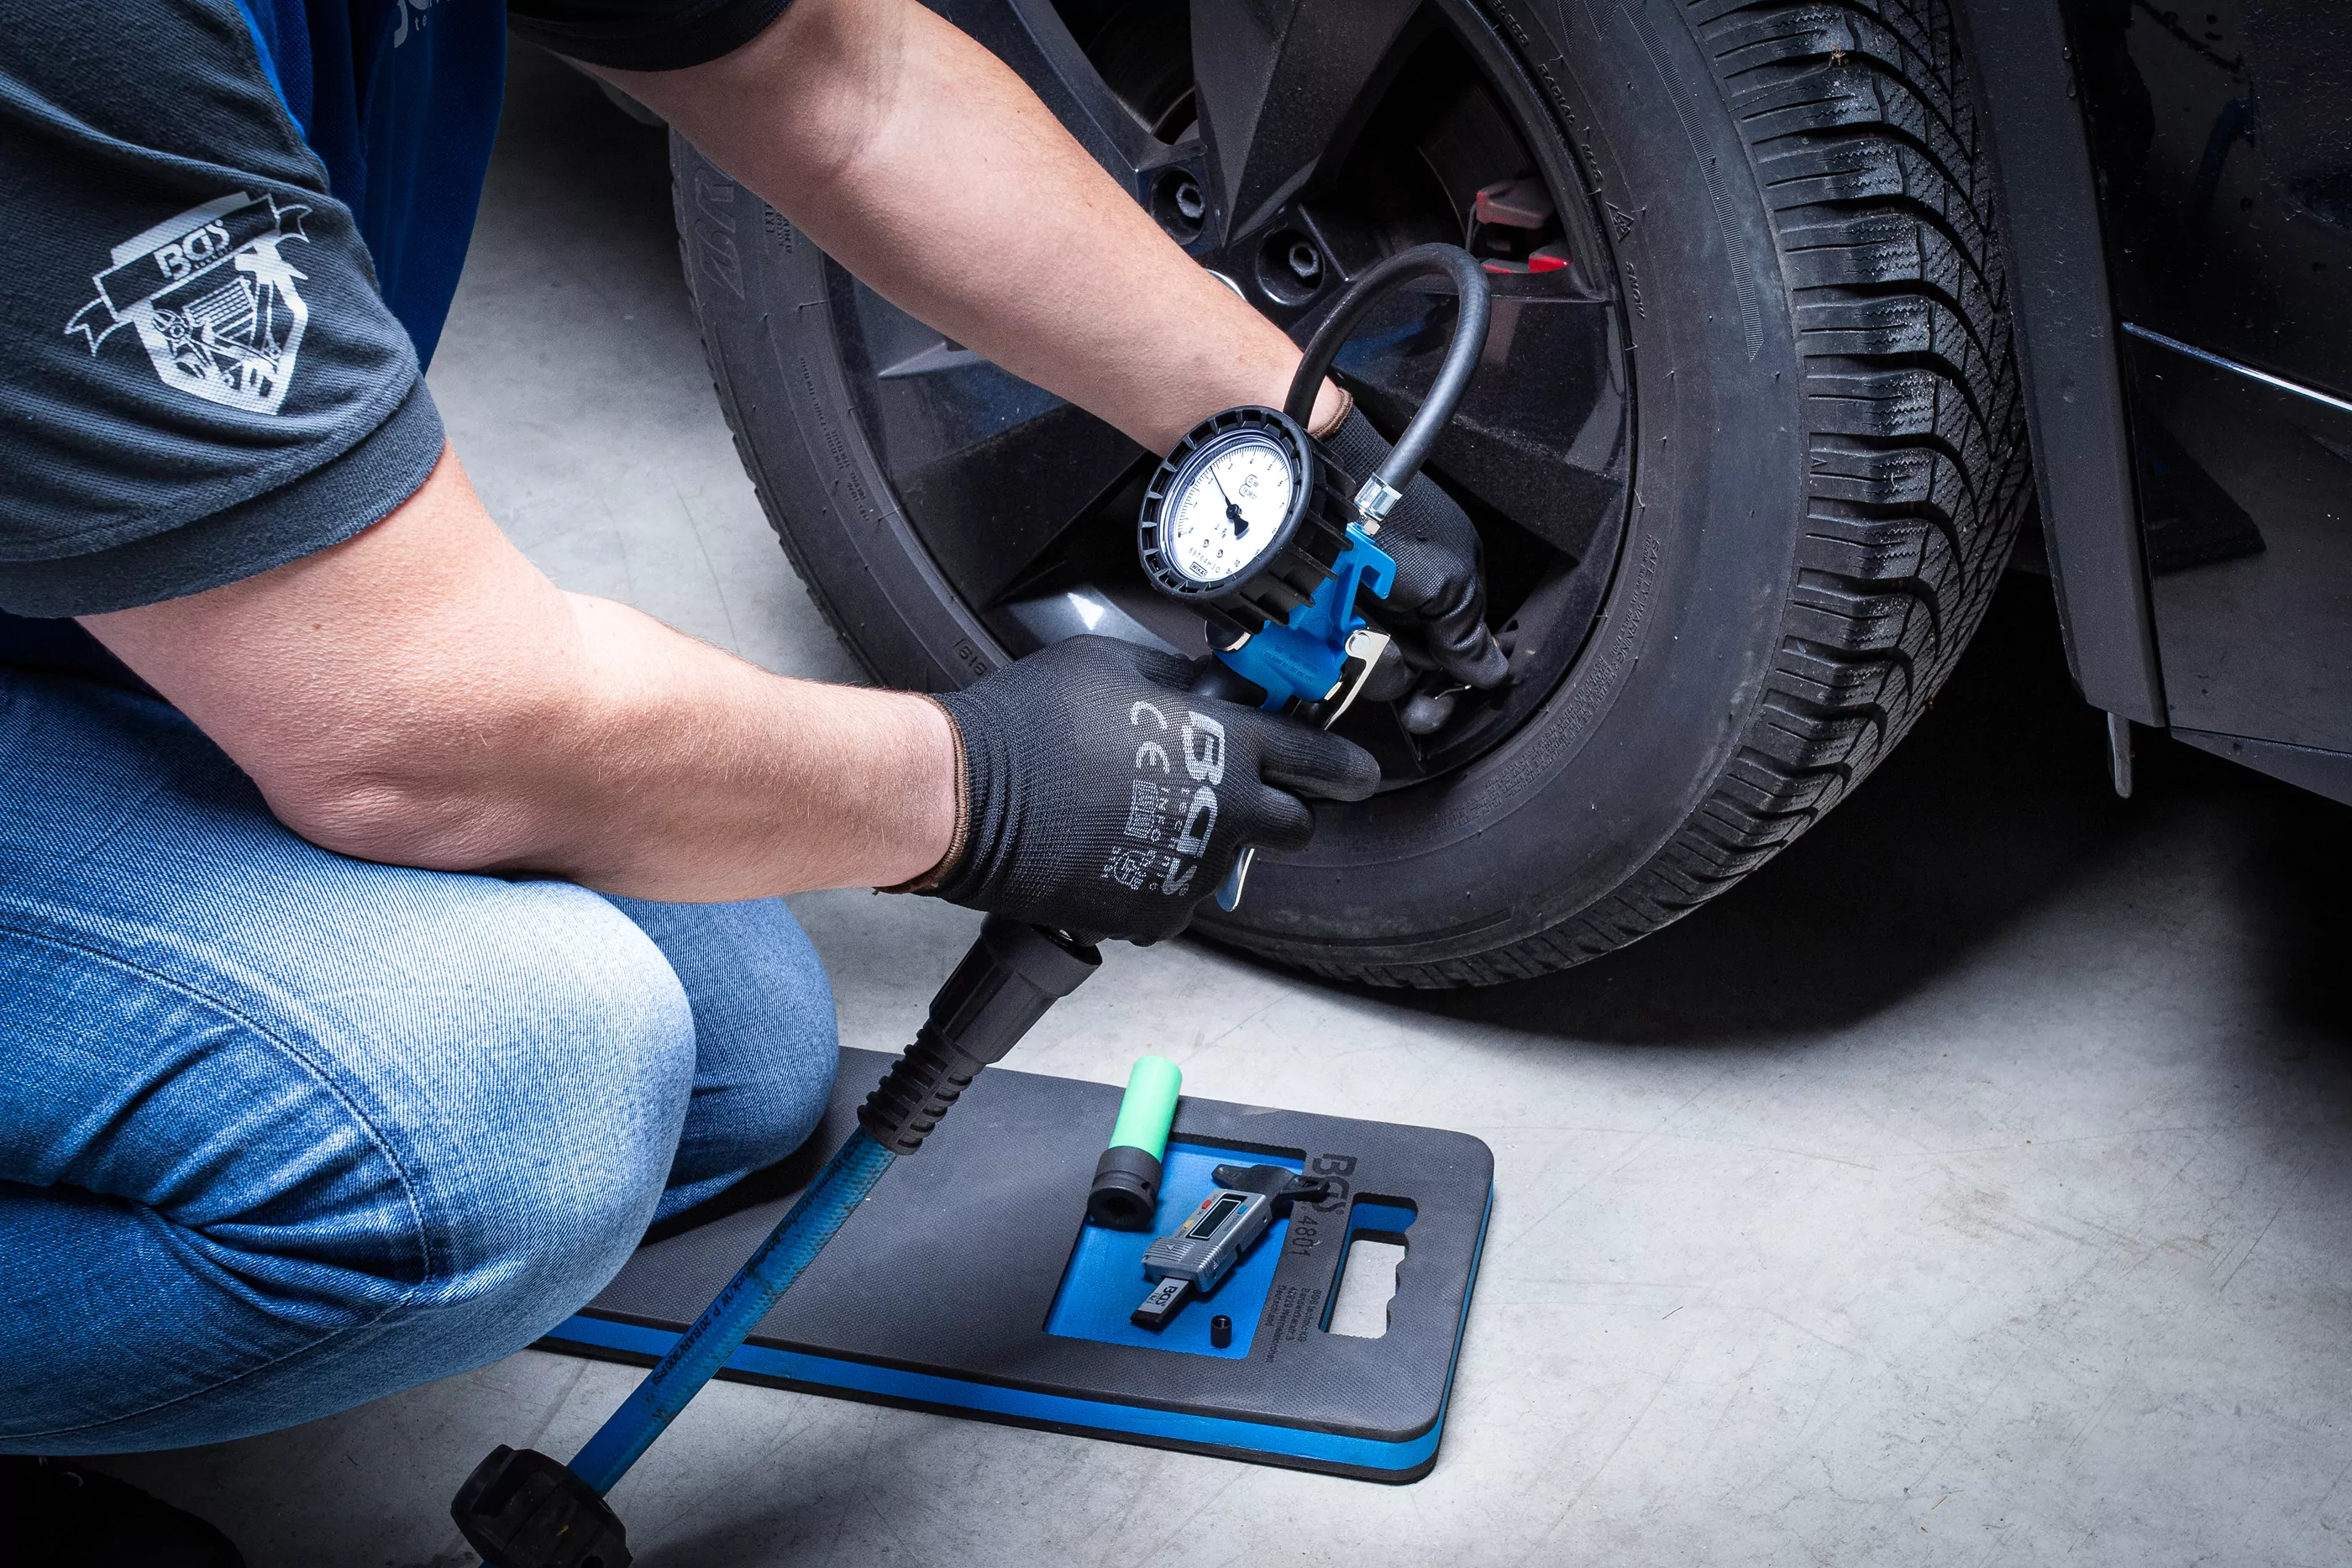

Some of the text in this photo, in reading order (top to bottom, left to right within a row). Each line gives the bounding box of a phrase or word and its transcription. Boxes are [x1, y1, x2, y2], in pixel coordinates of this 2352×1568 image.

[1536, 61, 1578, 127] RADIAL
[1625, 261, 1646, 318] SNOW
[153, 224, 230, 281] BGS
[1641, 538, 1659, 599] SAFETY
[1163, 711, 1226, 895] BGS
[1289, 1215, 1319, 1256] 4801
[1155, 1286, 1179, 1307] BGS
